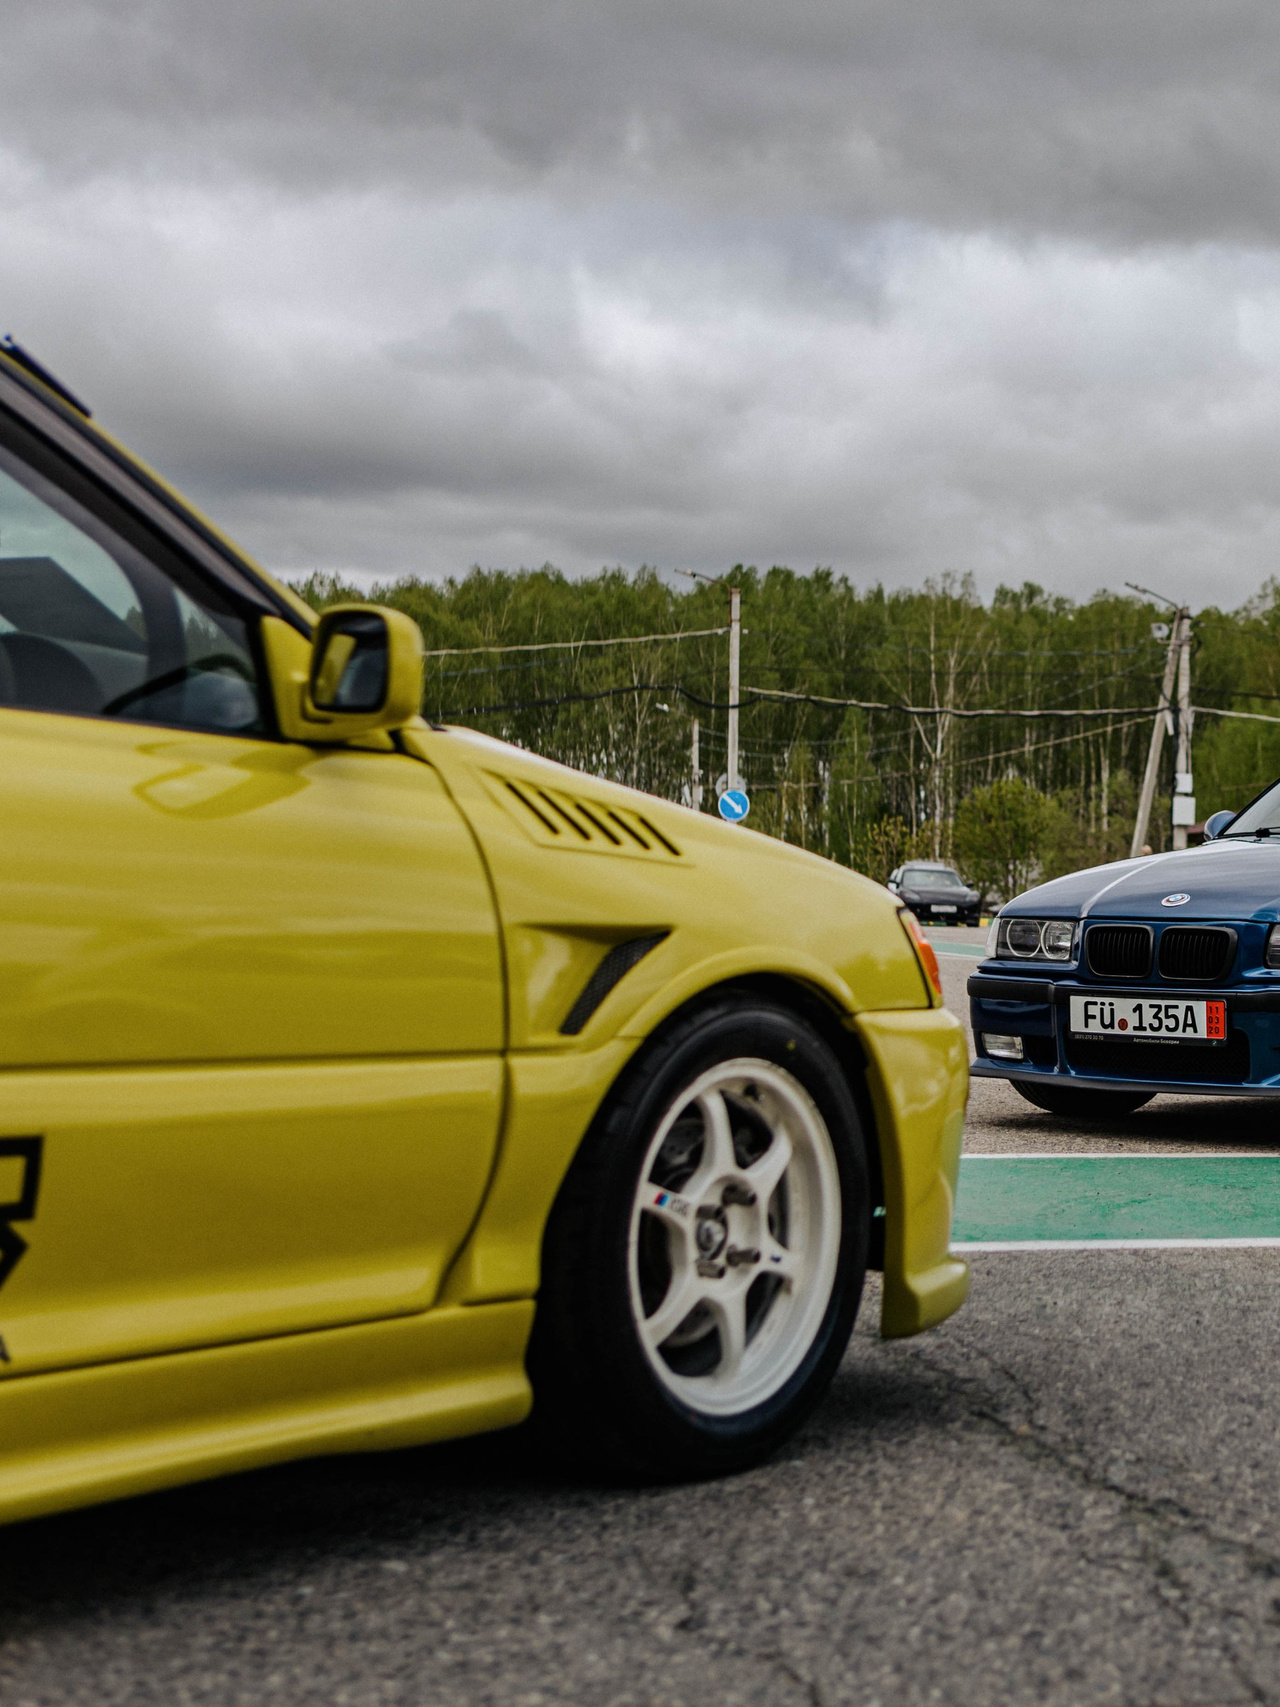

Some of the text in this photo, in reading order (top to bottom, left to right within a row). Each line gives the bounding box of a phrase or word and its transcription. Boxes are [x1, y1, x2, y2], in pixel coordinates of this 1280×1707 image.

[1209, 1005, 1219, 1014] 11
[1083, 1001, 1198, 1034] FÜ 135A
[1208, 1016, 1219, 1024] 03
[1208, 1026, 1220, 1035] 20
